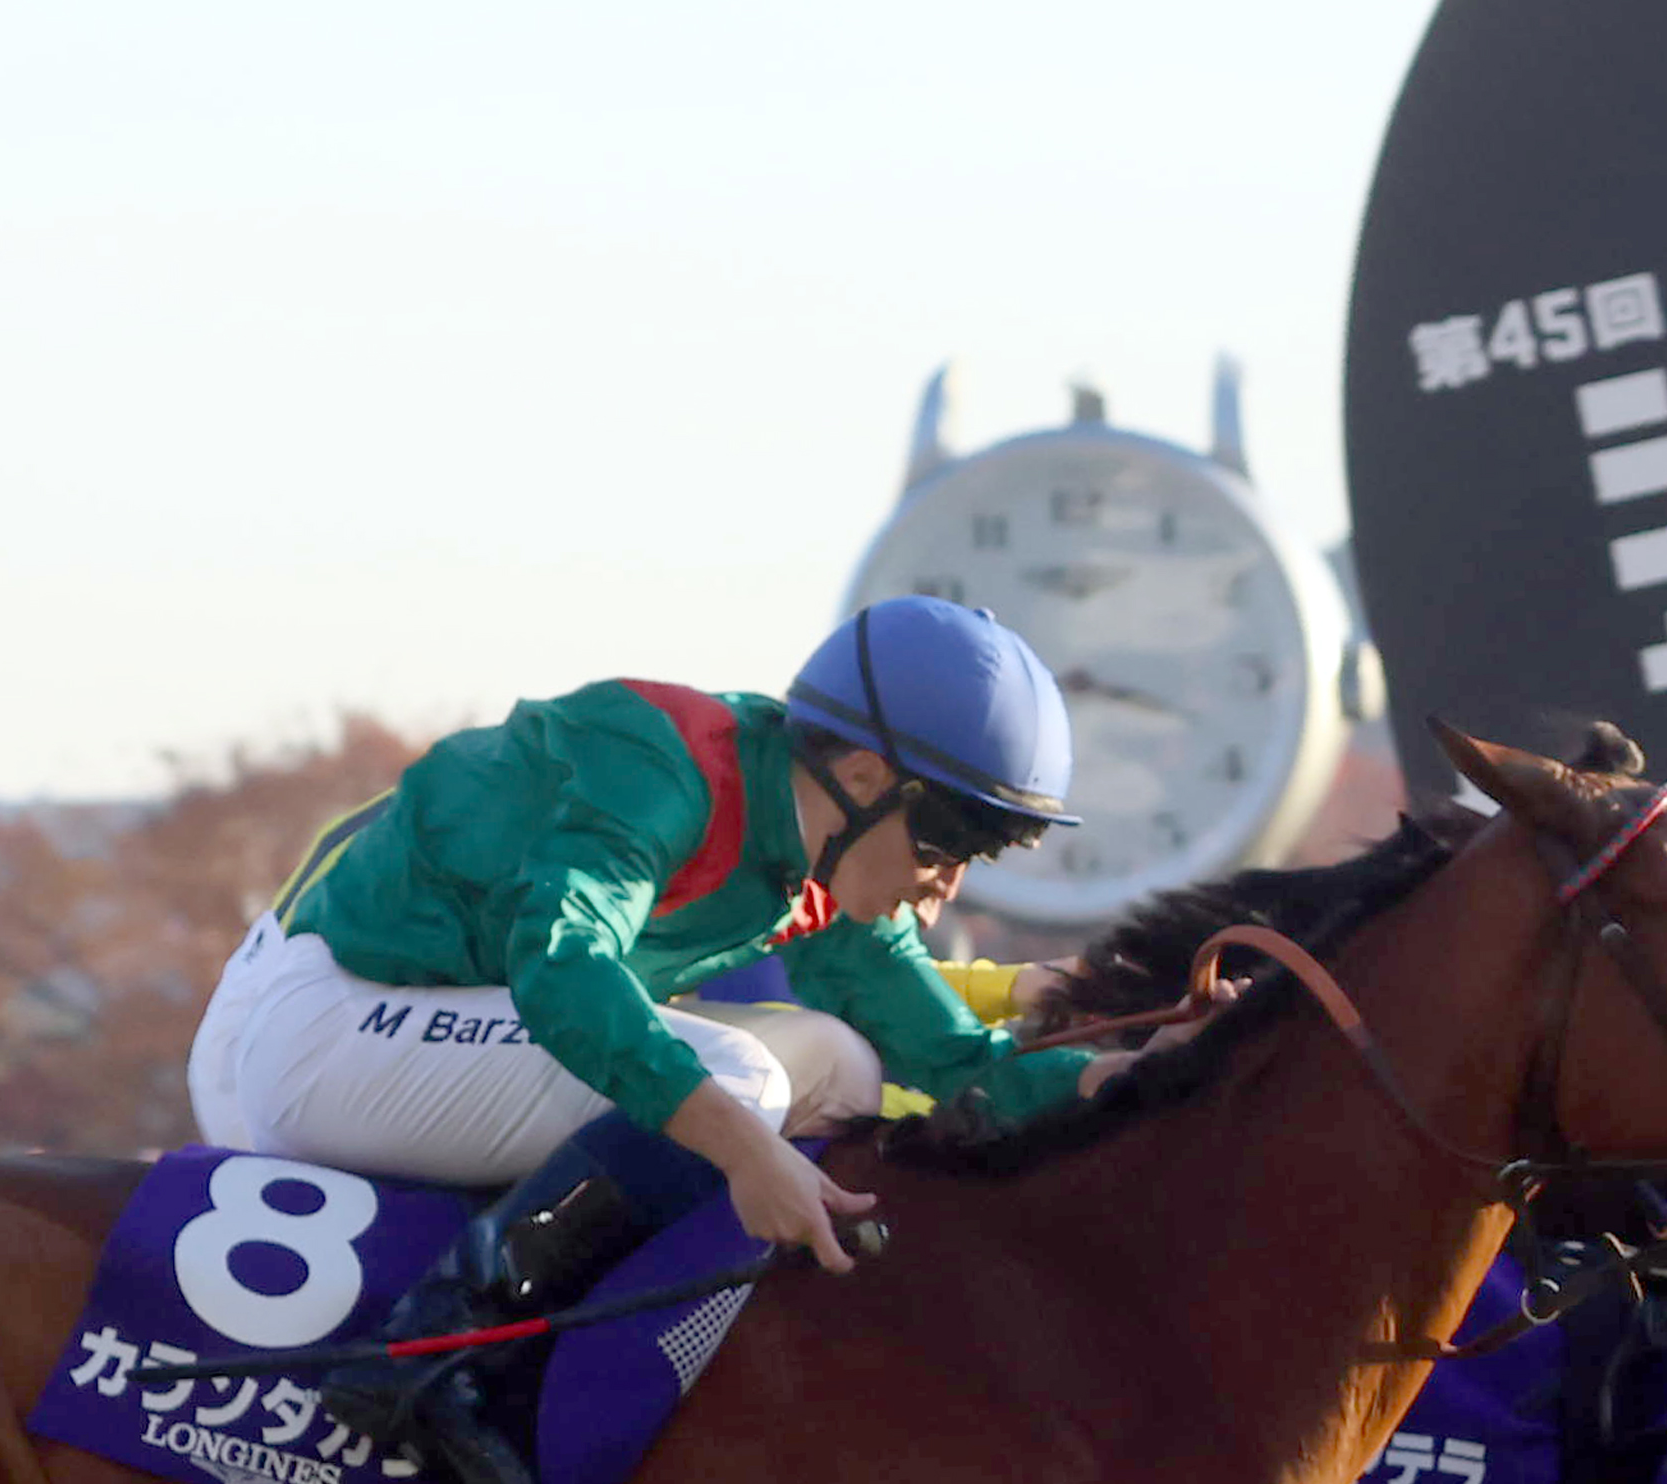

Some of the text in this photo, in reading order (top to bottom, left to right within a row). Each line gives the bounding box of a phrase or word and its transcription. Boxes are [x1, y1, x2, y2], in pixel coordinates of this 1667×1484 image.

[1407, 272, 1667, 392] 第45回
[358, 1001, 536, 1045] M Barz
[173, 1155, 378, 1348] 8
